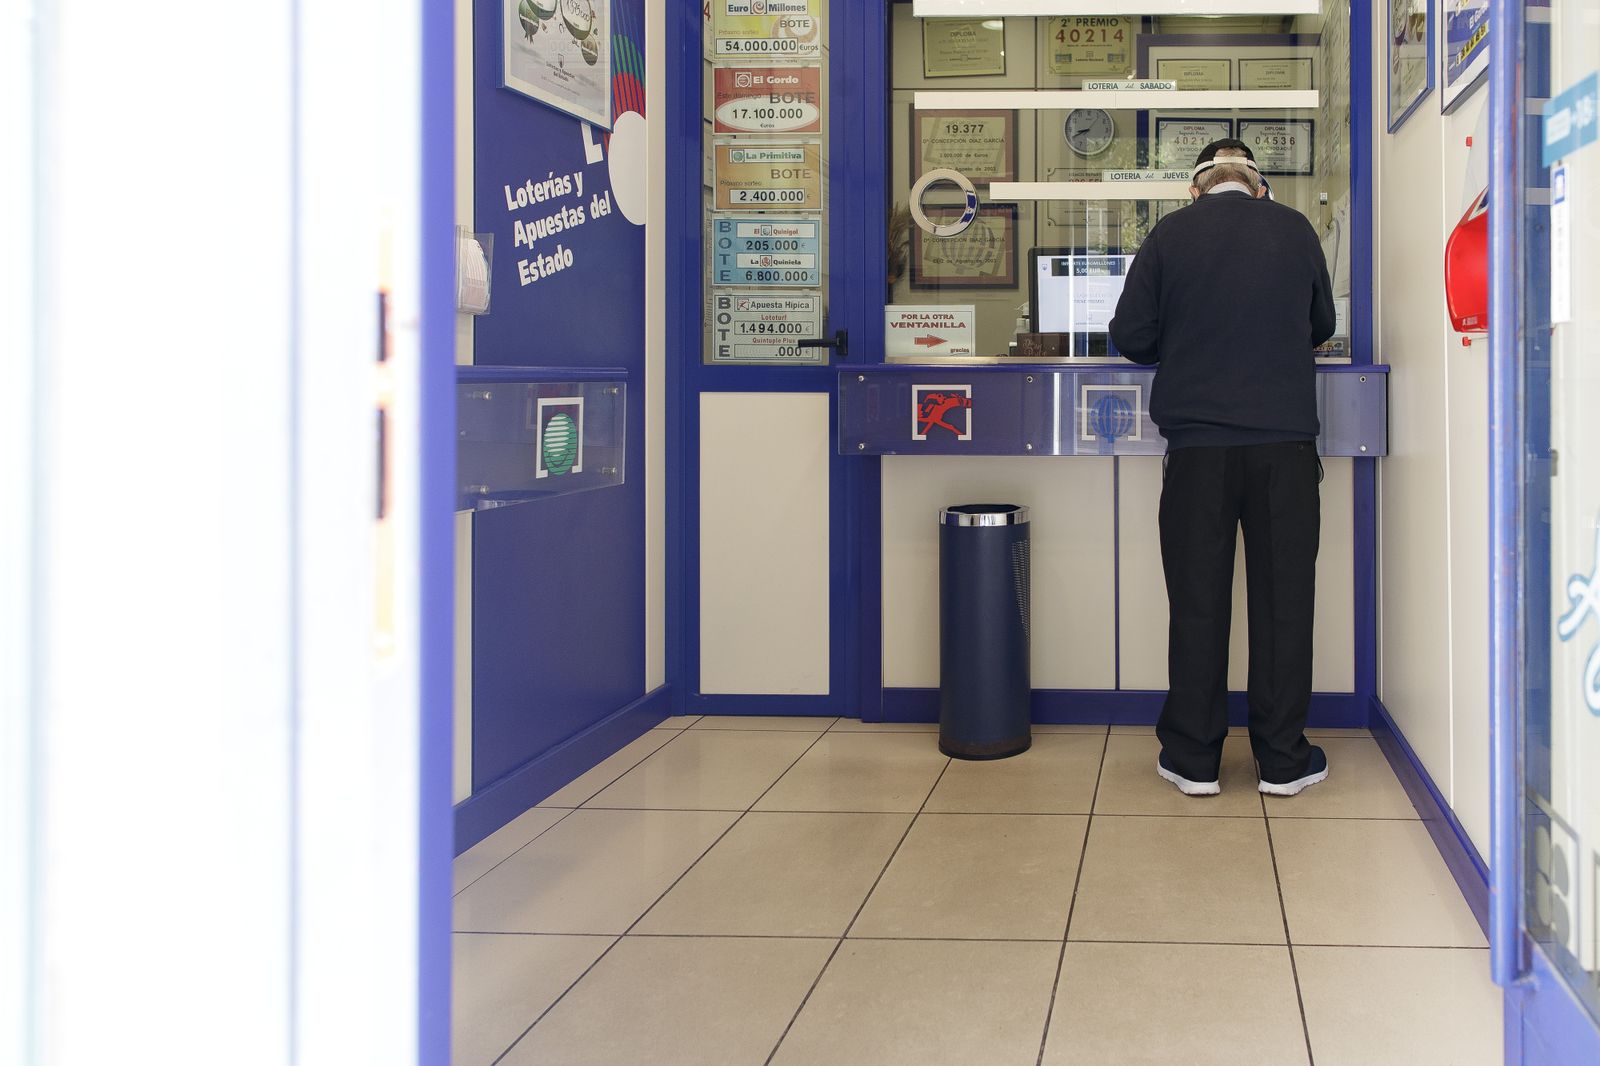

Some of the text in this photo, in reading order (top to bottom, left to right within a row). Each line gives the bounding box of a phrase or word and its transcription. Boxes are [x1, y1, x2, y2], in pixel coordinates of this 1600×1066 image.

[728, 4, 806, 12] Euro Millones
[780, 20, 810, 28] BOTE
[1076, 18, 1118, 27] PREMIO
[1056, 29, 1124, 42] 40214
[725, 40, 796, 52] 54.000.000
[767, 76, 799, 84] Gordo
[769, 92, 816, 104] BOTE
[733, 108, 803, 119] 17.100.000
[946, 124, 984, 134] 19.377
[1256, 137, 1296, 145] 04536
[771, 169, 812, 179] BOTE
[504, 170, 583, 211] Loterías y
[740, 191, 804, 202] 2.400.000
[514, 190, 612, 249] Apuestas del
[746, 241, 798, 250] 205.000
[718, 221, 732, 282] BOTE
[518, 244, 574, 286] Estado
[746, 271, 808, 282] 6.800.000
[717, 297, 732, 357] BOTE
[741, 323, 801, 333] 1.494.000
[775, 347, 801, 357] .000
